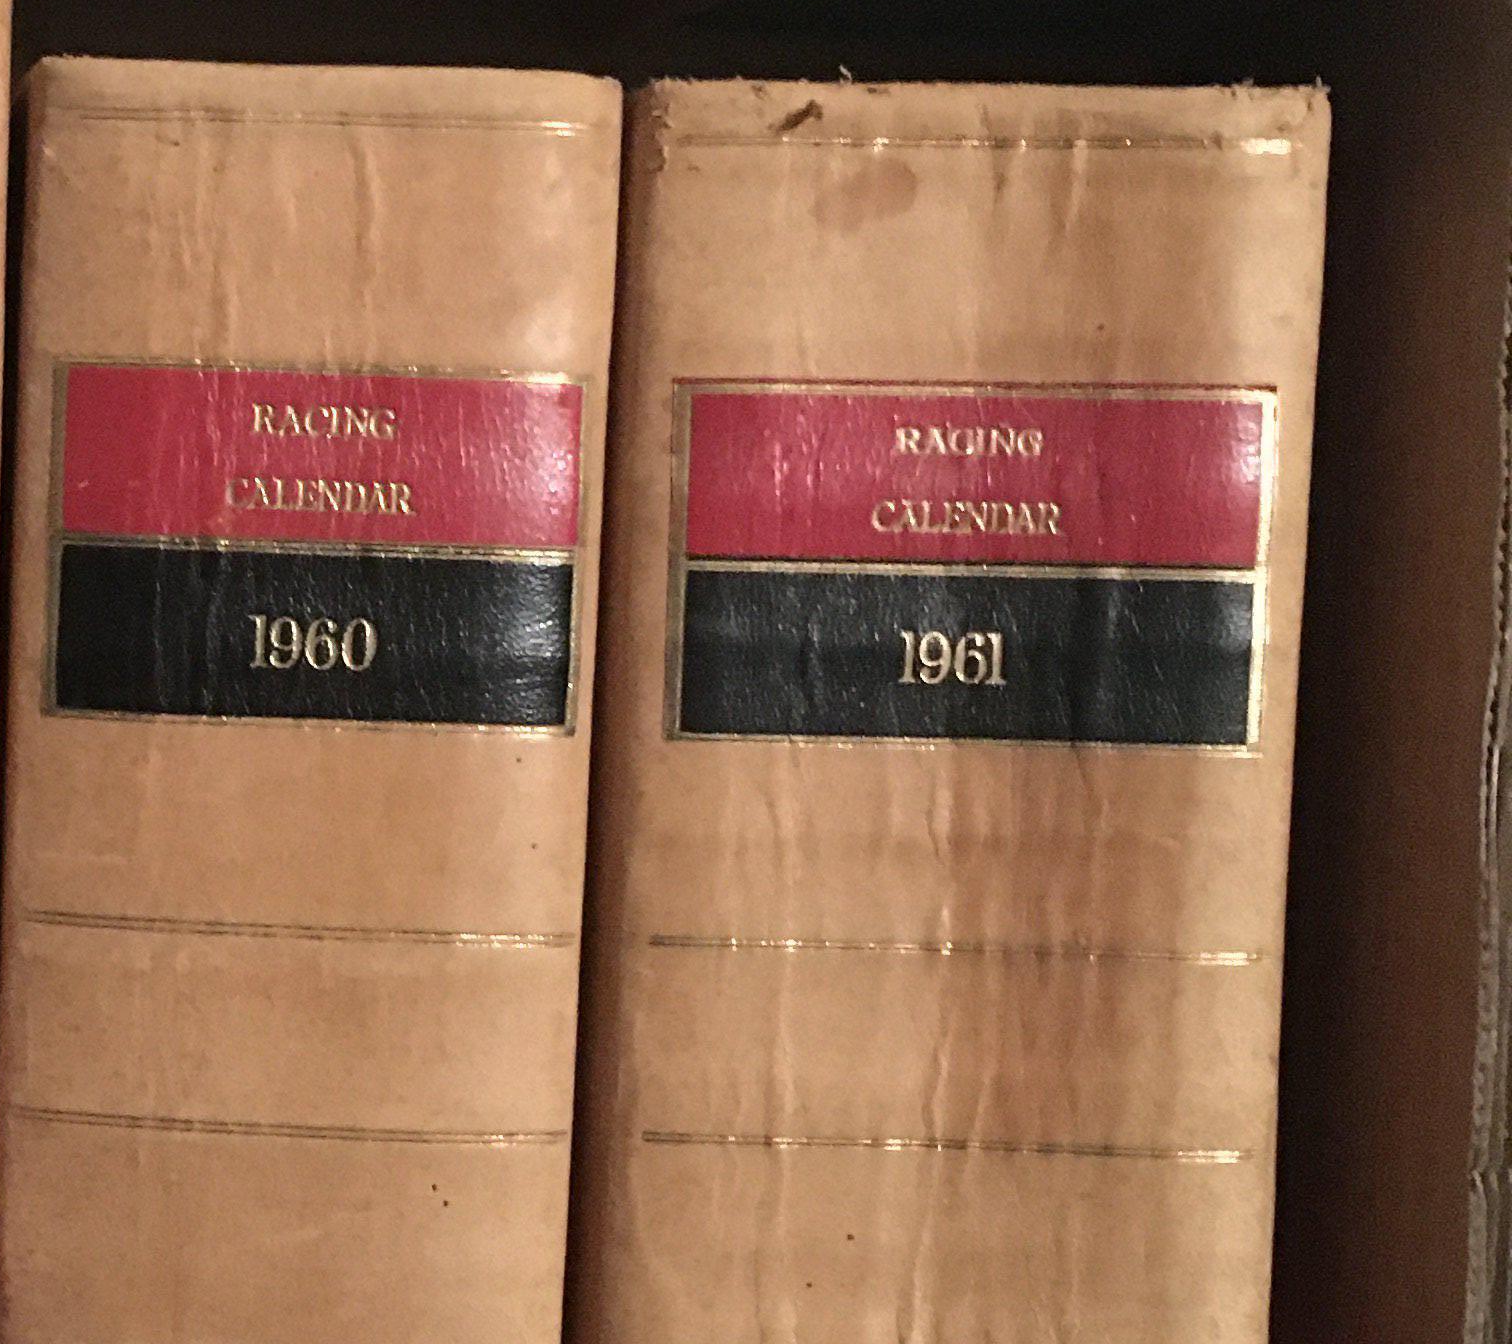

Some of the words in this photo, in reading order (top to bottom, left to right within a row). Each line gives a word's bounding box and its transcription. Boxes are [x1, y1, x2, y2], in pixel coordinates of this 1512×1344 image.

[252, 406, 399, 443] RACING
[894, 424, 1044, 461] RACING
[224, 479, 414, 517] CALENDAR
[871, 497, 1065, 537] CALENDAR
[248, 616, 378, 673] 1960
[898, 631, 1006, 688] 1961
